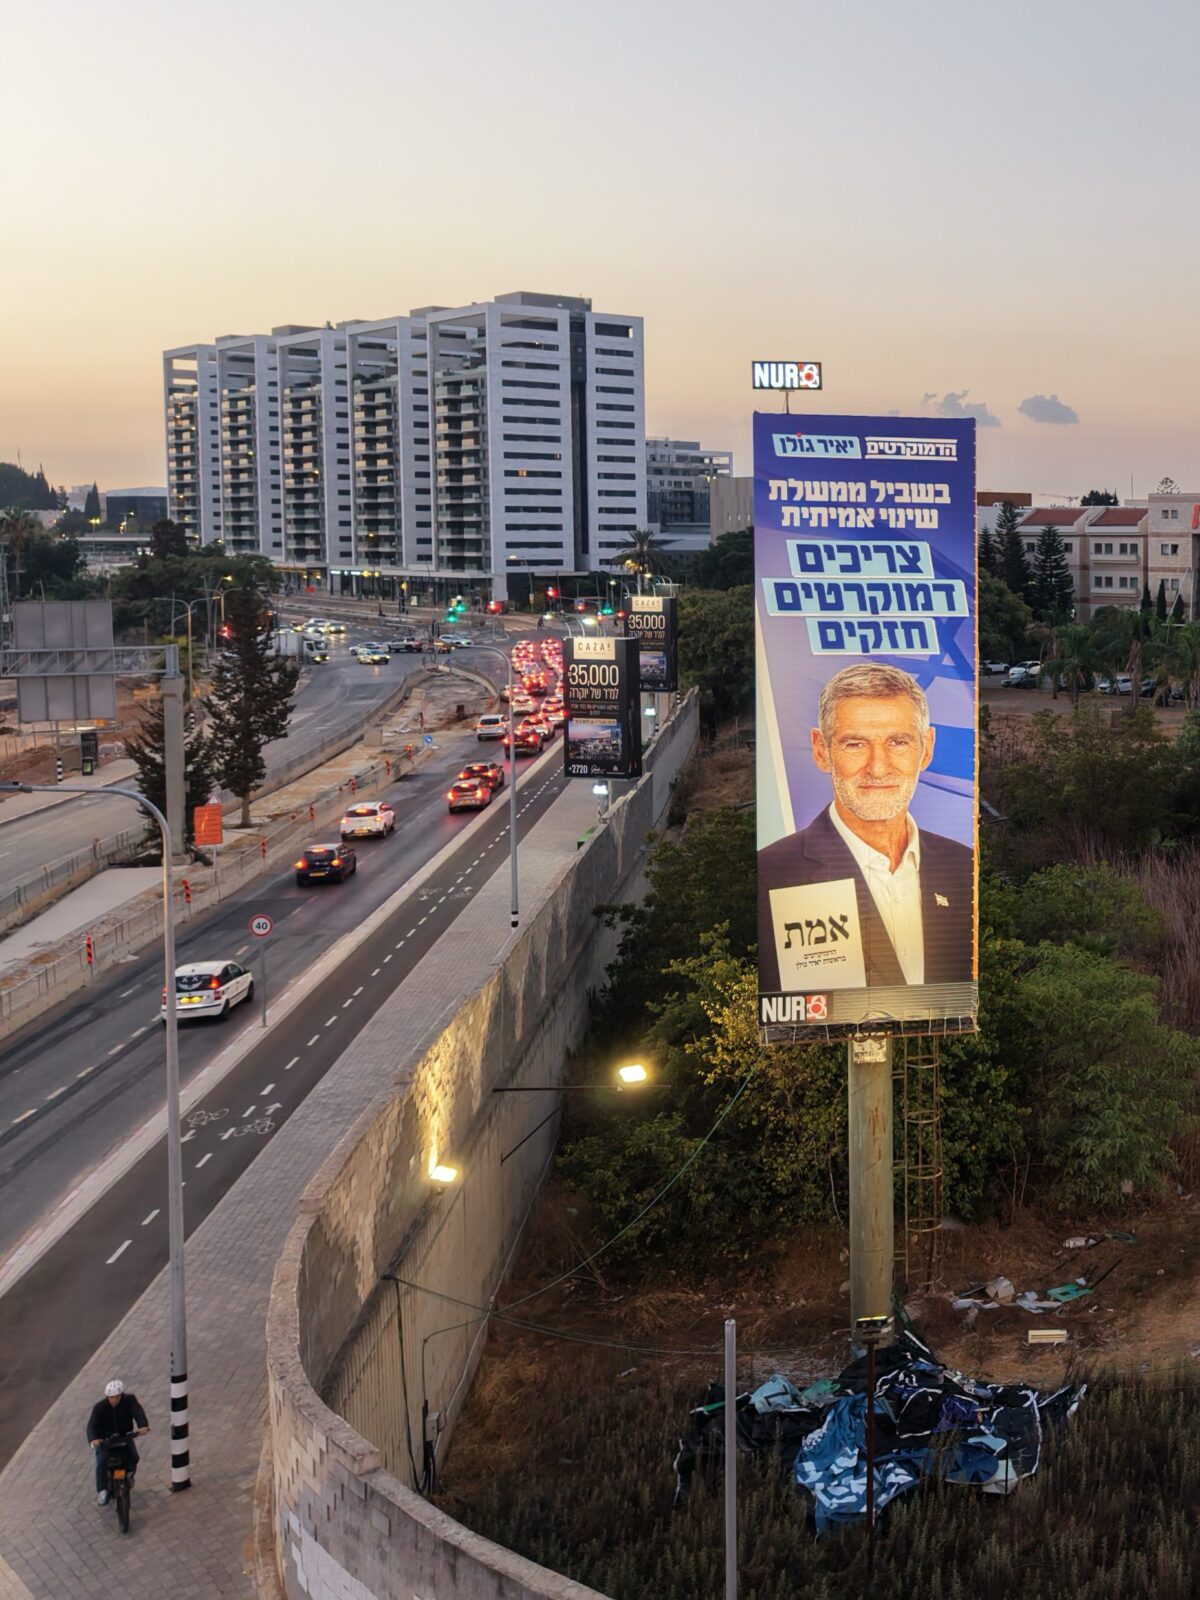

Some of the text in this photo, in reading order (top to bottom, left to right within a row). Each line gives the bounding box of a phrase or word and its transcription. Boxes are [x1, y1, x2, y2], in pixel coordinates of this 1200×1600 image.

[779, 435, 854, 454] יאיר גולן
[866, 441, 957, 457] הדמוקרטים
[768, 477, 951, 504] בשביל ממשלת
[781, 505, 938, 529] שינוי אמיתית
[796, 543, 924, 574] צריכים
[773, 581, 956, 616] דמוקרטים
[817, 620, 929, 654] חזקים
[255, 921, 268, 930] 40
[784, 913, 850, 949] אמת
